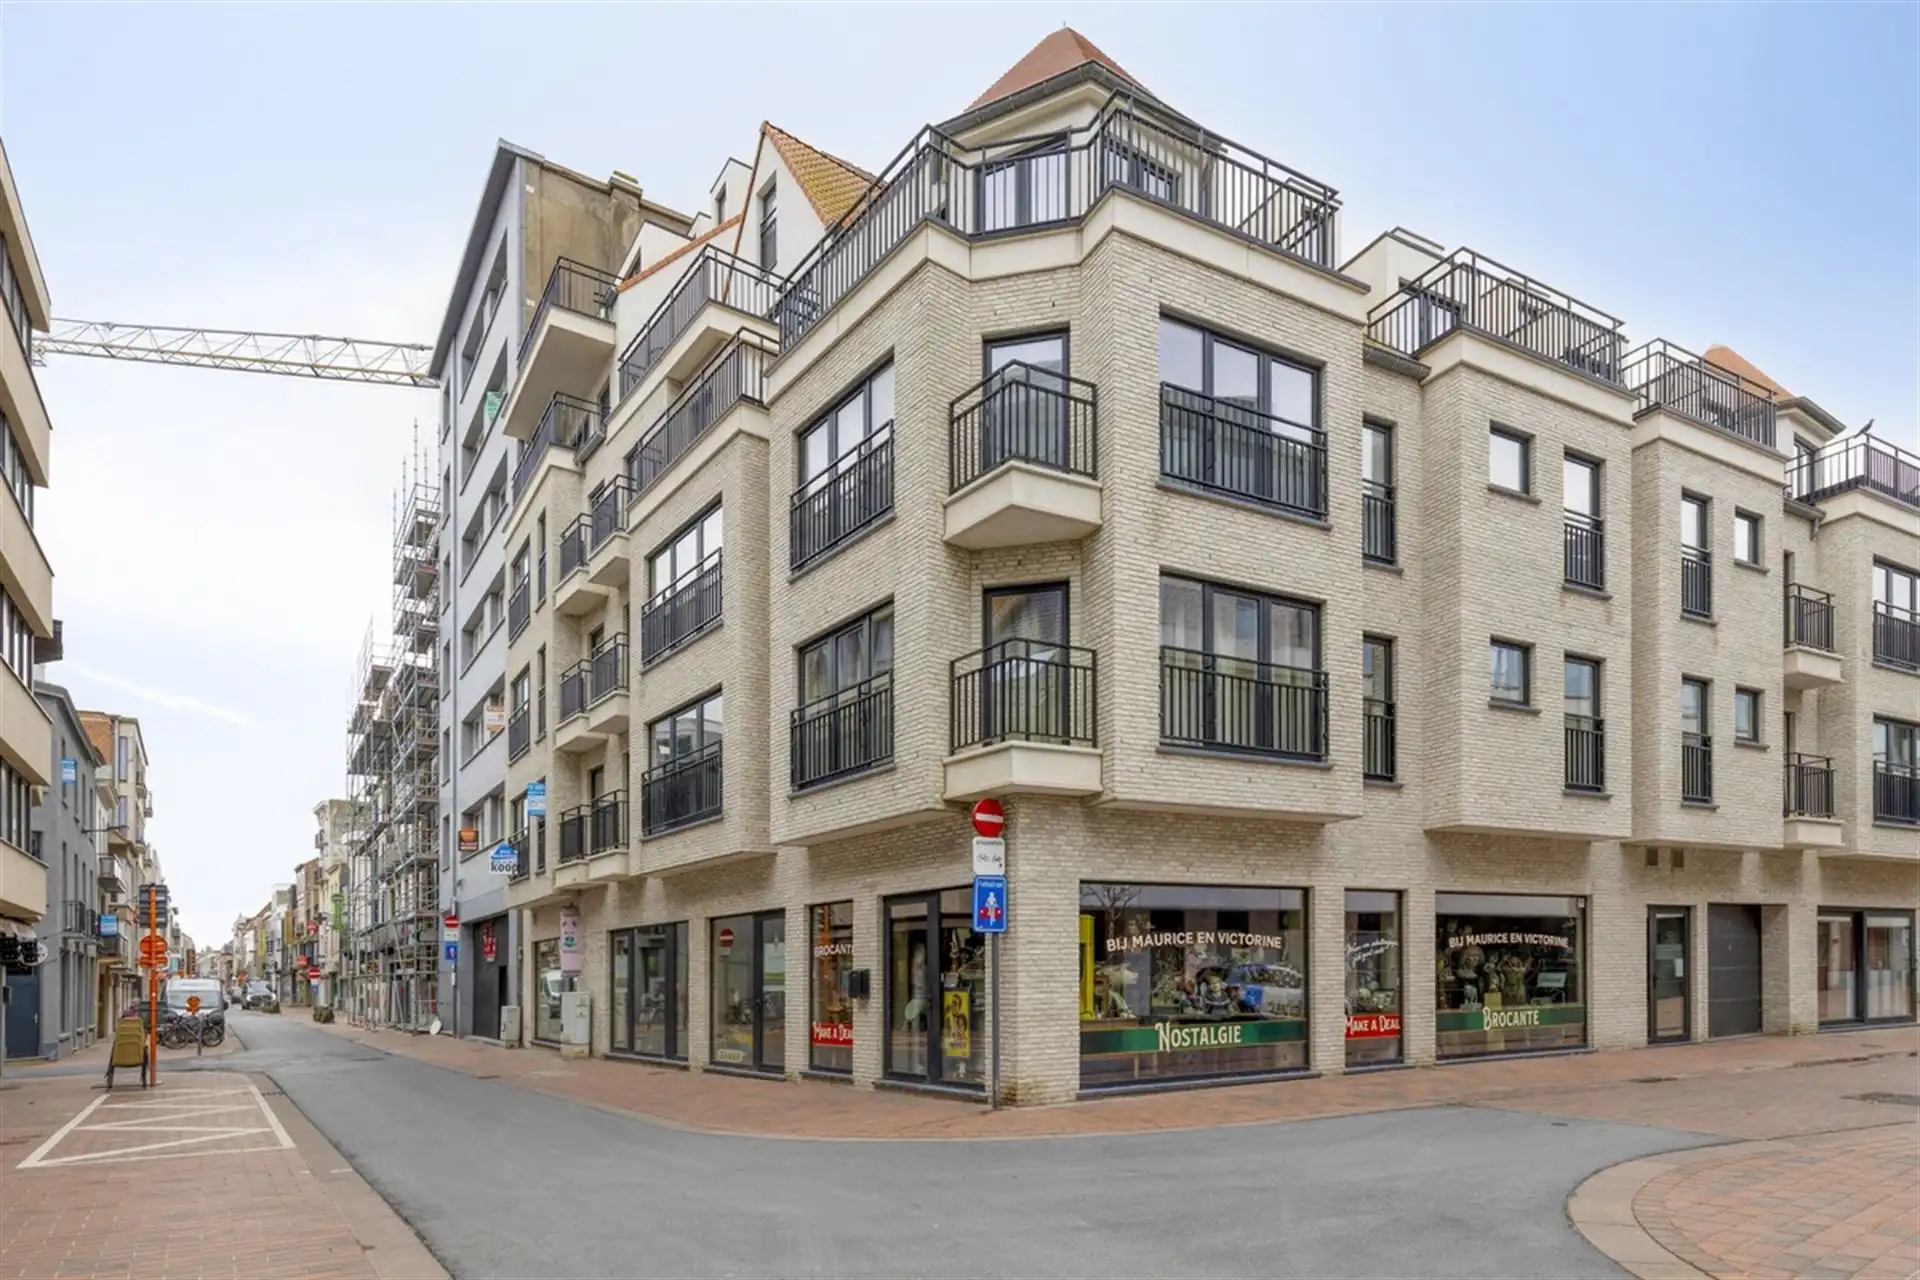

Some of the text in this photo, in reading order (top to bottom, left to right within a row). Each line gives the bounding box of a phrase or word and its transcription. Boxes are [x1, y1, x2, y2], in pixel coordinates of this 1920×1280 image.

[814, 944, 855, 957] BROCANT
[1106, 931, 1283, 952] BIJ MAURICE EN VICTORINE
[1448, 932, 1569, 948] BIJ MAURICE EN VICTORINE
[1482, 1006, 1540, 1031] BROCANTE
[1154, 1021, 1242, 1053] NOSTALGIE
